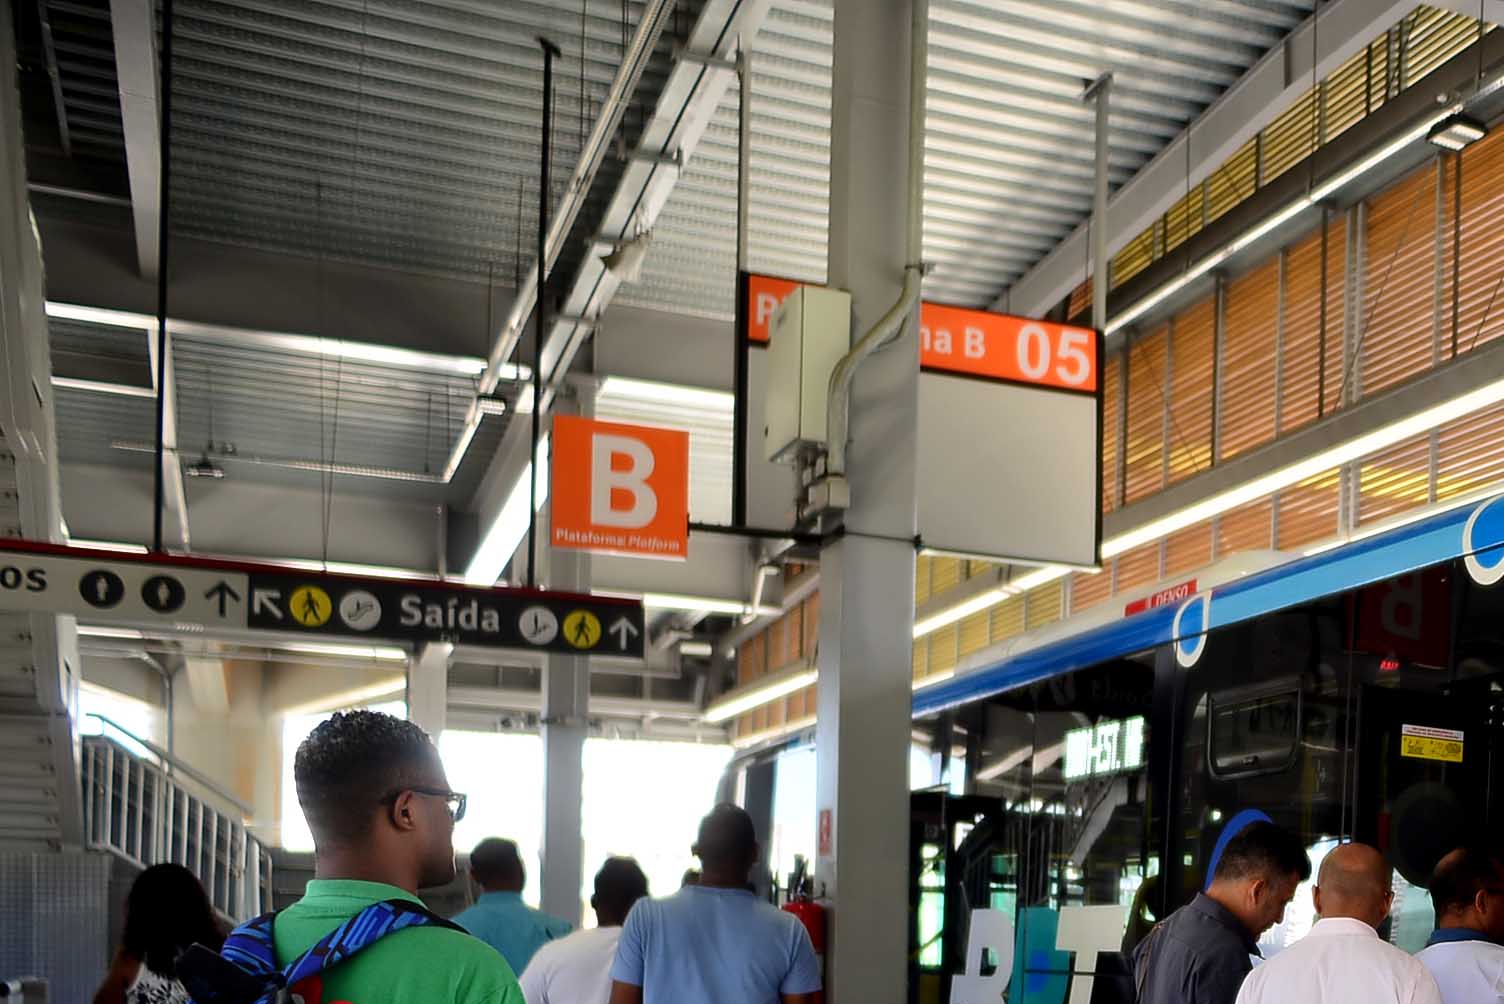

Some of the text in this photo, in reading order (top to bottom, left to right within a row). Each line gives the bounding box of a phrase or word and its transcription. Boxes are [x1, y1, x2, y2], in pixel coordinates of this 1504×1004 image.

[964, 326, 986, 358] B
[1016, 322, 1091, 386] 05
[590, 431, 658, 530] B
[0, 566, 48, 592] os
[400, 593, 500, 633] Saída
